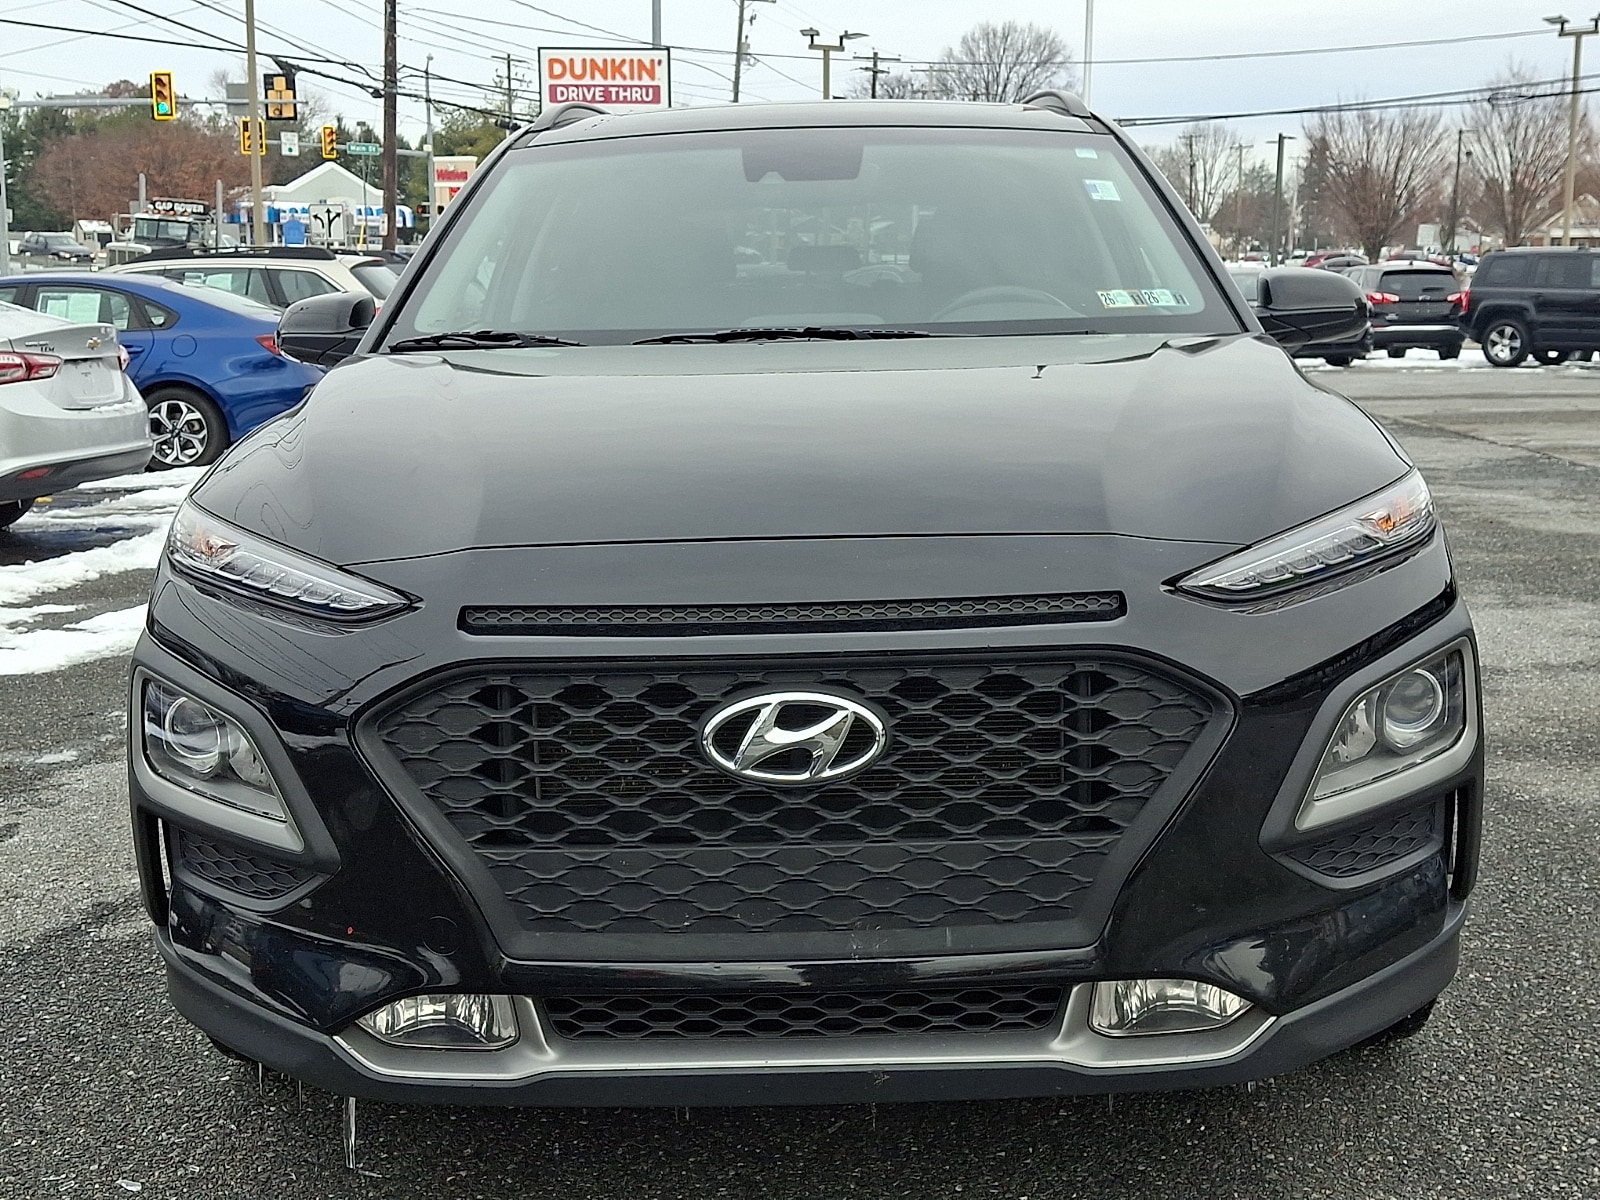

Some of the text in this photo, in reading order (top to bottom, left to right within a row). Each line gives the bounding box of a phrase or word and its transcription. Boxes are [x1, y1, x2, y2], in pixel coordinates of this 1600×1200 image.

[548, 57, 662, 81] DUNKIN'
[556, 86, 654, 101] DRIVE THRU
[1101, 293, 1116, 306] 26
[1144, 291, 1159, 304] 26
